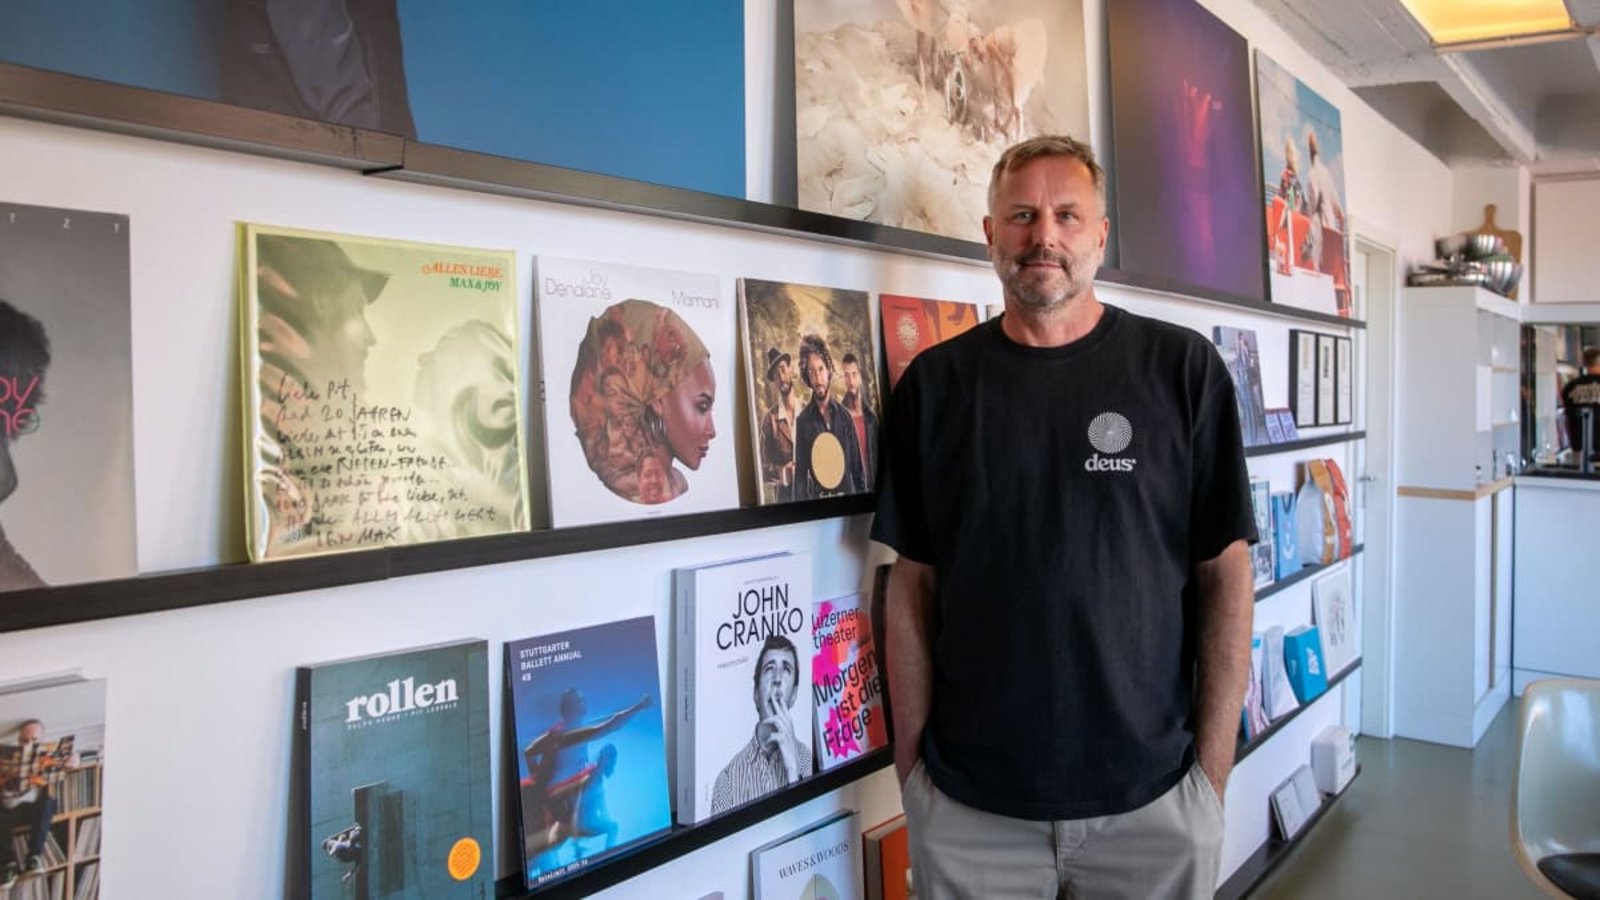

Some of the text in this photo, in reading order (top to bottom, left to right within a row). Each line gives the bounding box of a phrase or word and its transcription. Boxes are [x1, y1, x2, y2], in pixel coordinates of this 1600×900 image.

[732, 583, 789, 620] JOHN
[520, 641, 570, 659] STUTTGARTER
[716, 607, 804, 650] CRANKO
[813, 627, 857, 649] theater
[521, 650, 582, 670] BALLETT ANNUAL
[812, 649, 876, 707] Morgen
[345, 676, 459, 723] rollen
[833, 674, 882, 722] ist die
[823, 707, 872, 757] Frage
